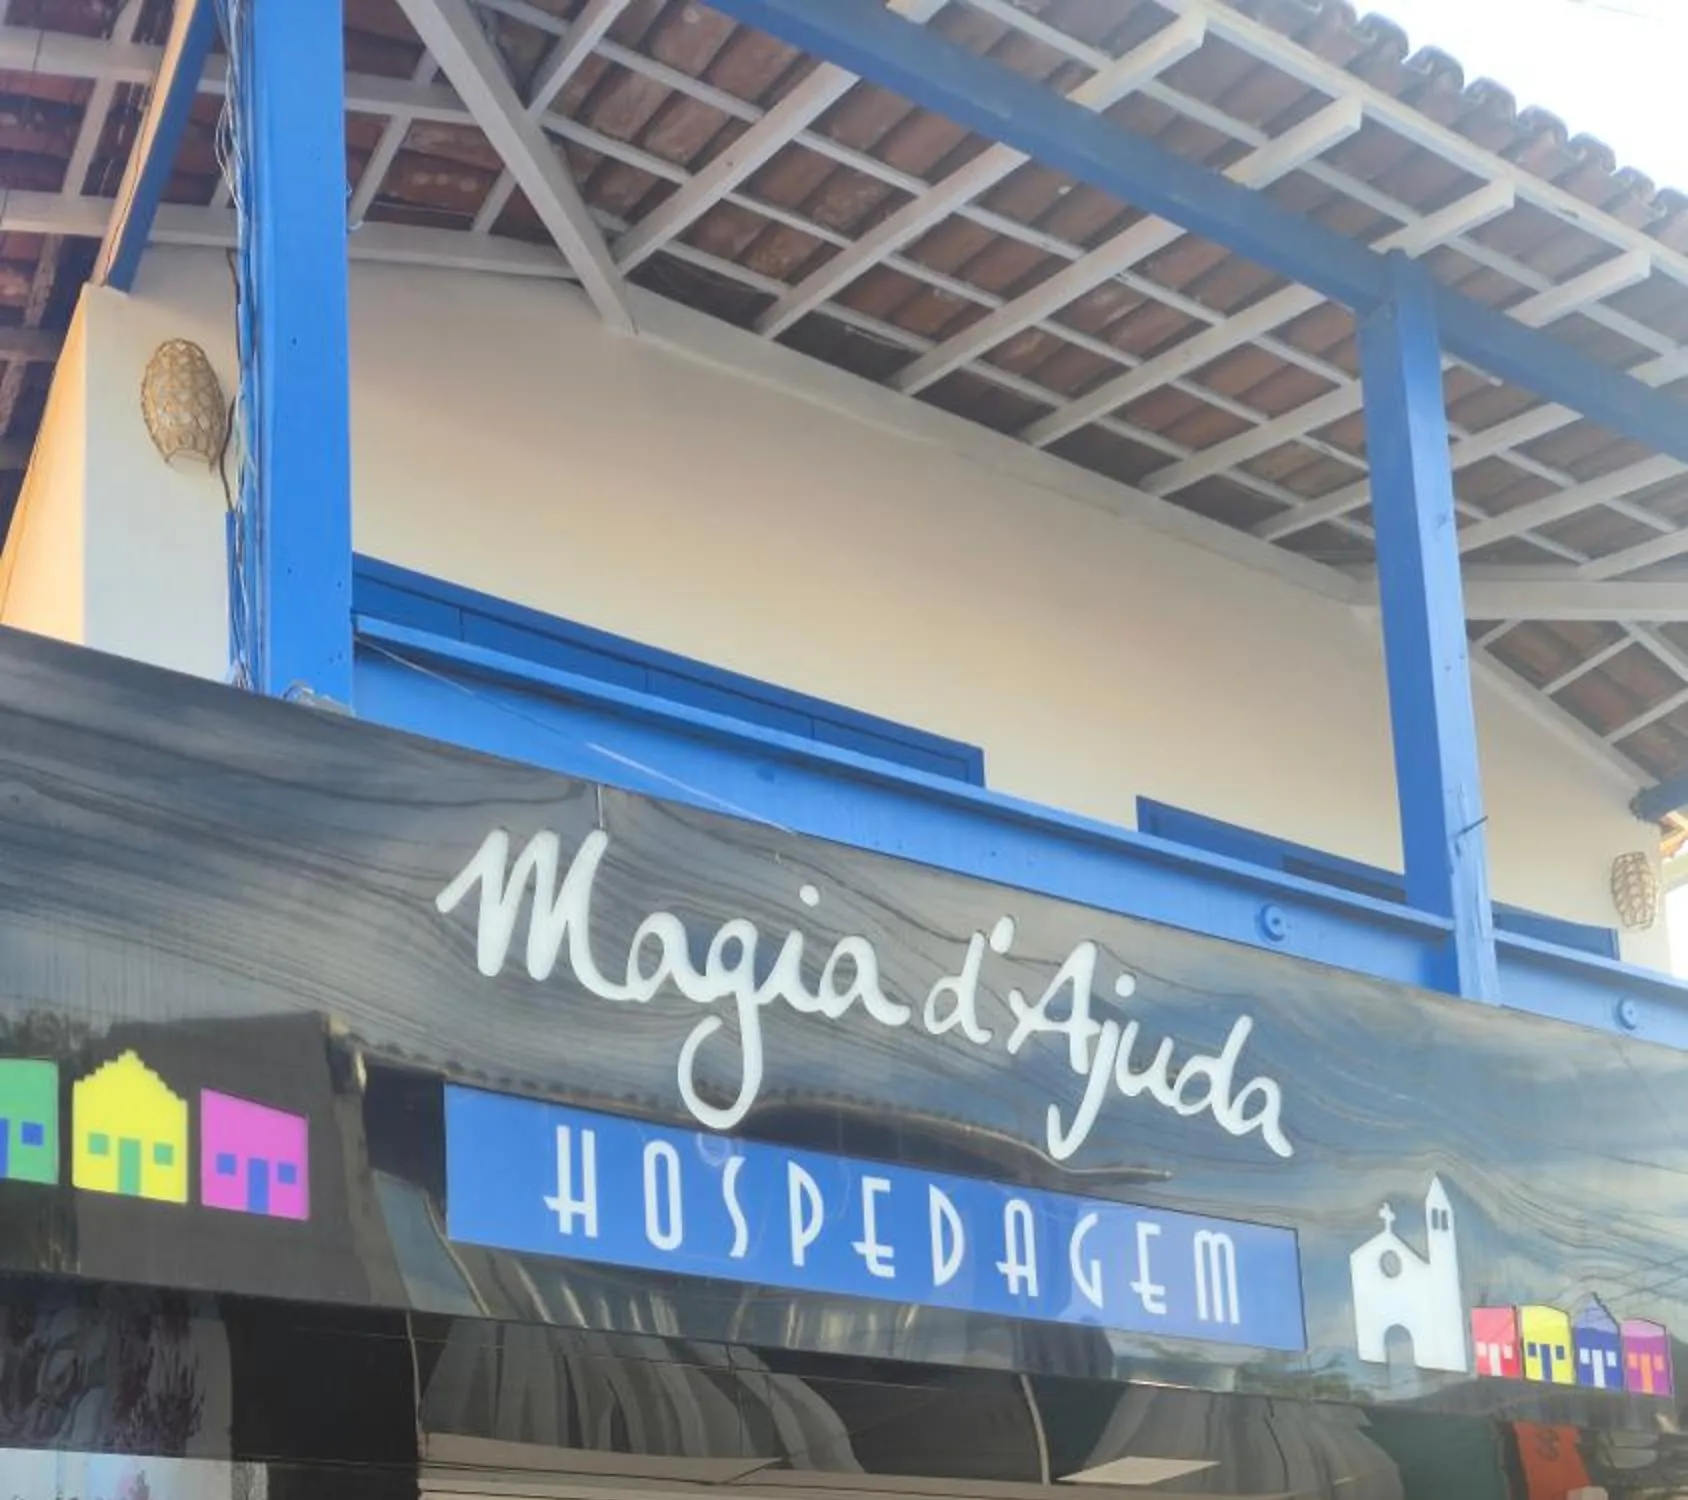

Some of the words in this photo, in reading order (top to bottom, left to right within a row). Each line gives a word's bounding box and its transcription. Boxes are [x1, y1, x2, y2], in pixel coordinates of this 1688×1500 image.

[436, 828, 912, 1129] Magia
[923, 915, 1294, 1160] d'Ajuda
[544, 1125, 1241, 1325] HOSPEDAGEM
